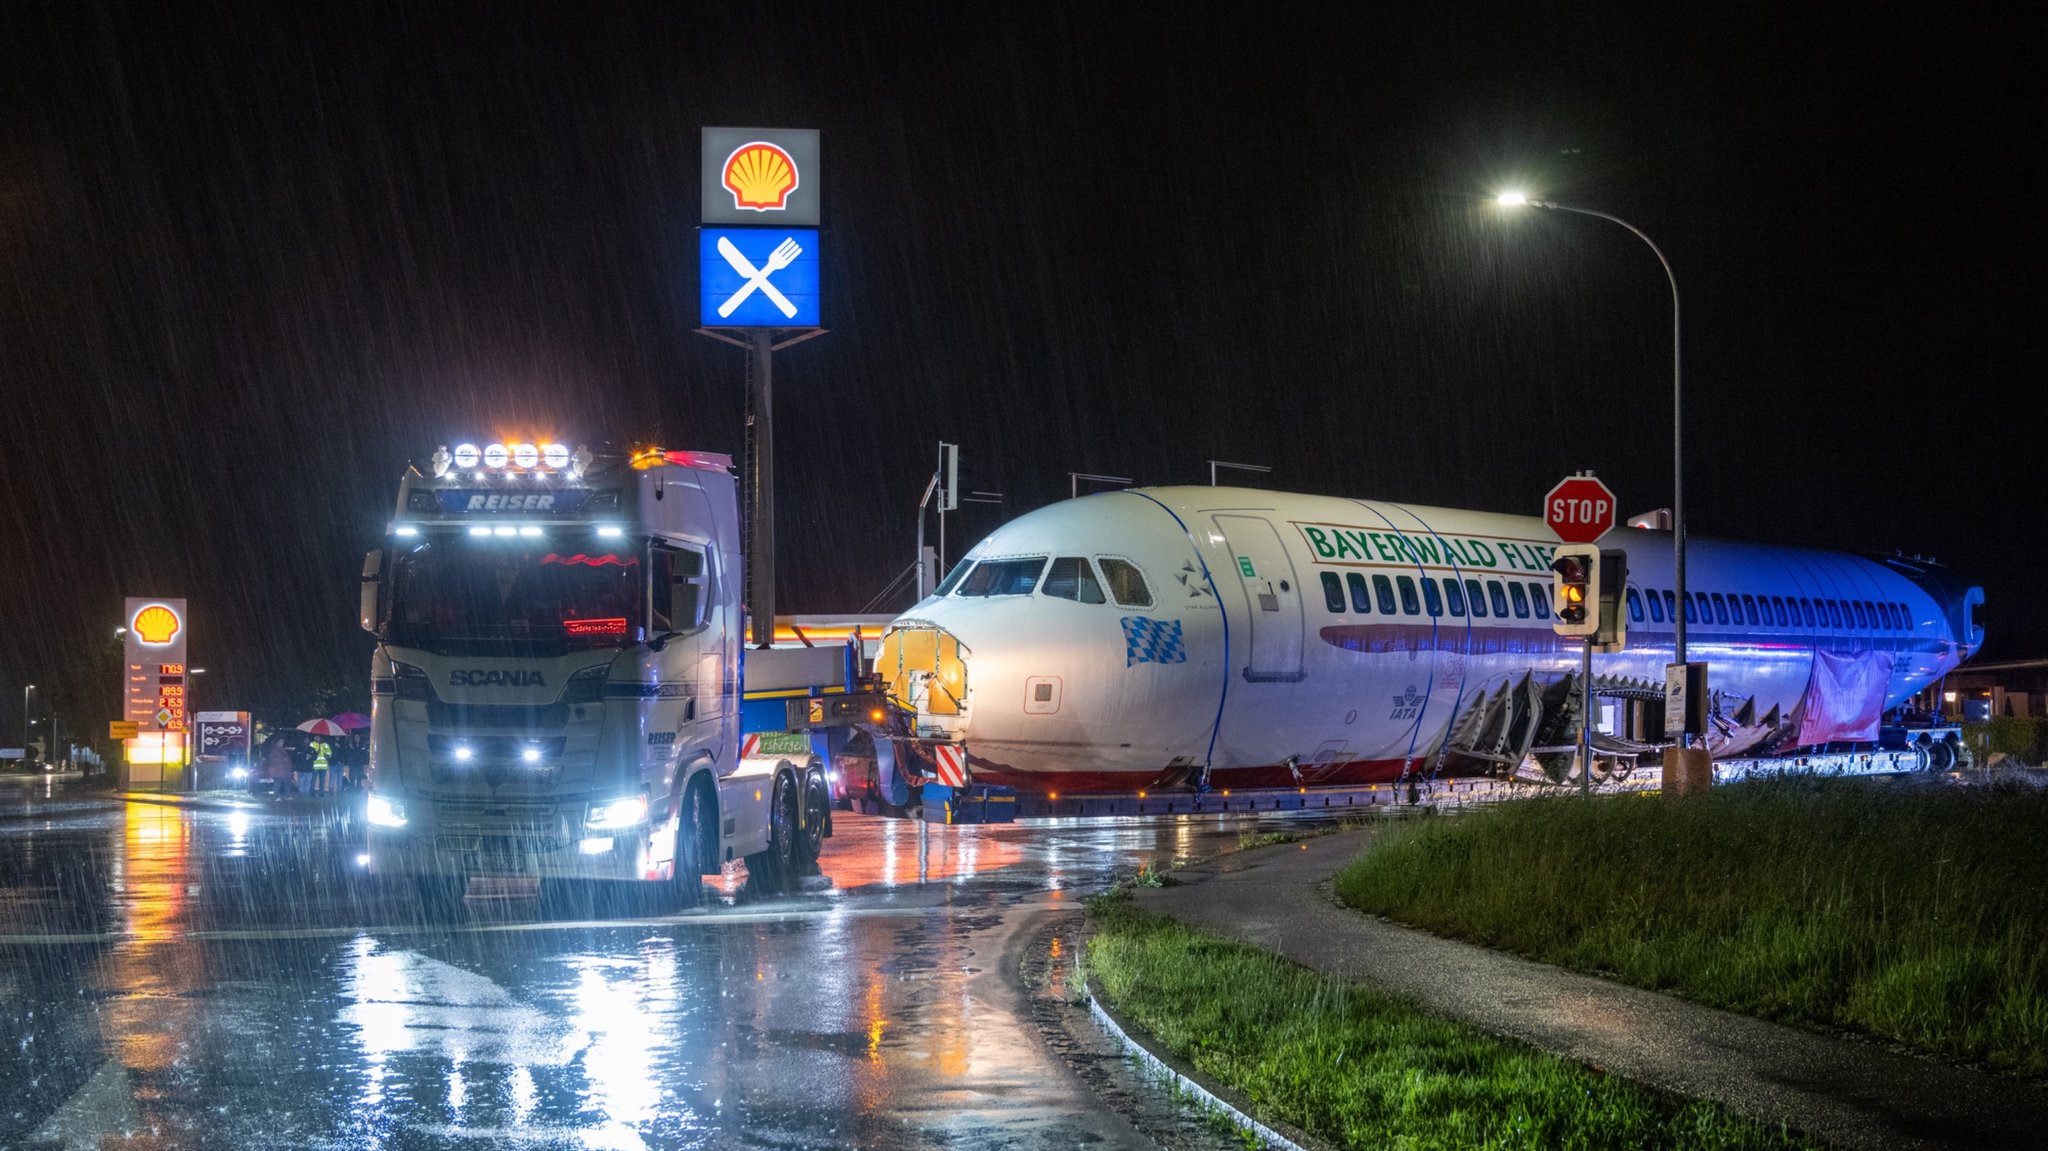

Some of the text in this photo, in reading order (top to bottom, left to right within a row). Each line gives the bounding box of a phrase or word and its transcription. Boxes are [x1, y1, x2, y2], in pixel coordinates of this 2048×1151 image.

[467, 494, 555, 510] REISER
[1552, 498, 1608, 524] STOP
[1305, 527, 1556, 571] BAYERWALD FLIE
[448, 669, 546, 687] SCANIA
[162, 686, 183, 696] 189.9
[1389, 708, 1417, 720] IATA
[647, 732, 676, 745] REISER
